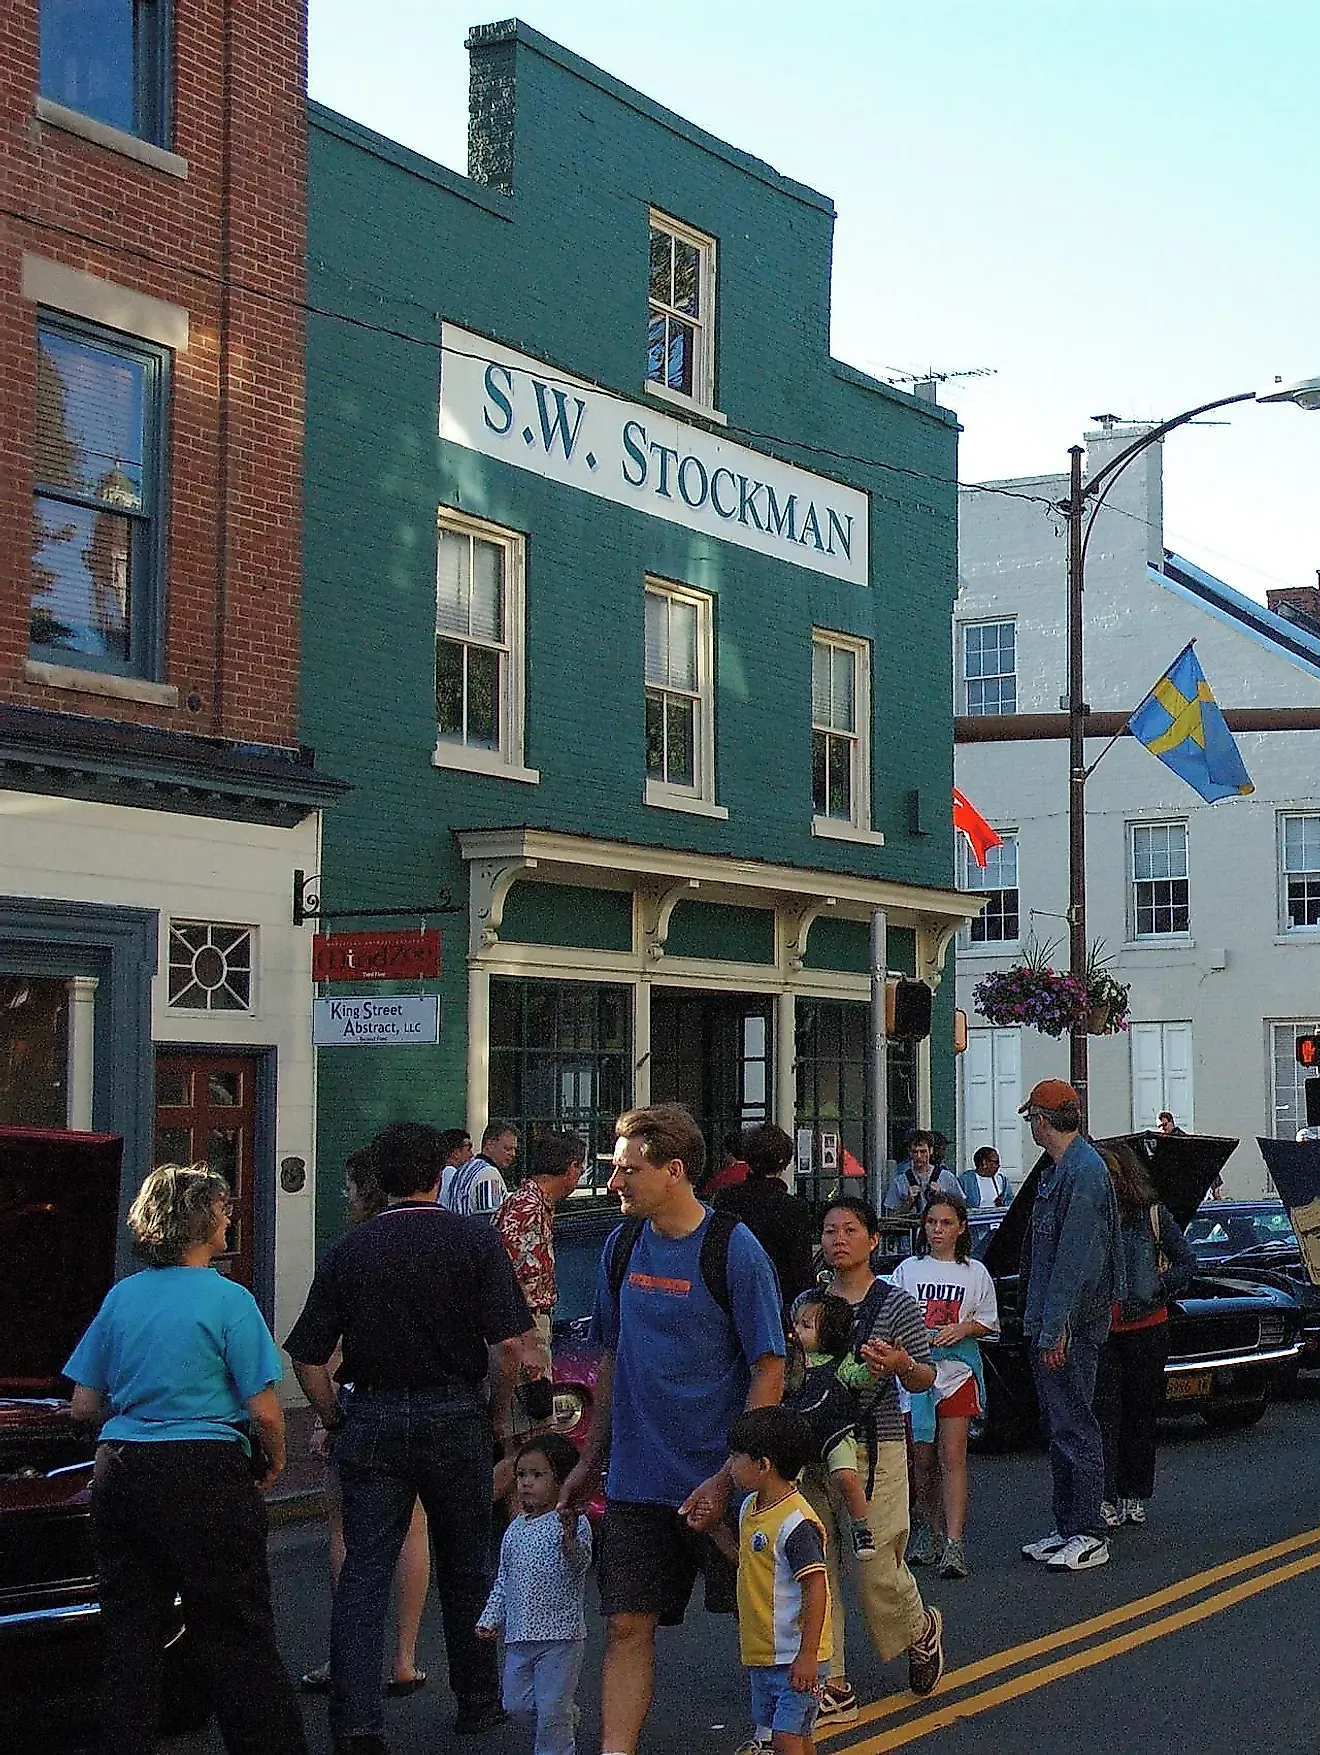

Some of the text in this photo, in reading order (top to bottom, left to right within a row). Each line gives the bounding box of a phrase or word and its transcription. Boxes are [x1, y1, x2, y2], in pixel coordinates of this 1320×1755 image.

[482, 363, 855, 561] S.W. STOCKMAN
[330, 1001, 403, 1020] King Street
[343, 1018, 421, 1037] Abstract, LLC
[916, 1283, 966, 1301] YOUTH
